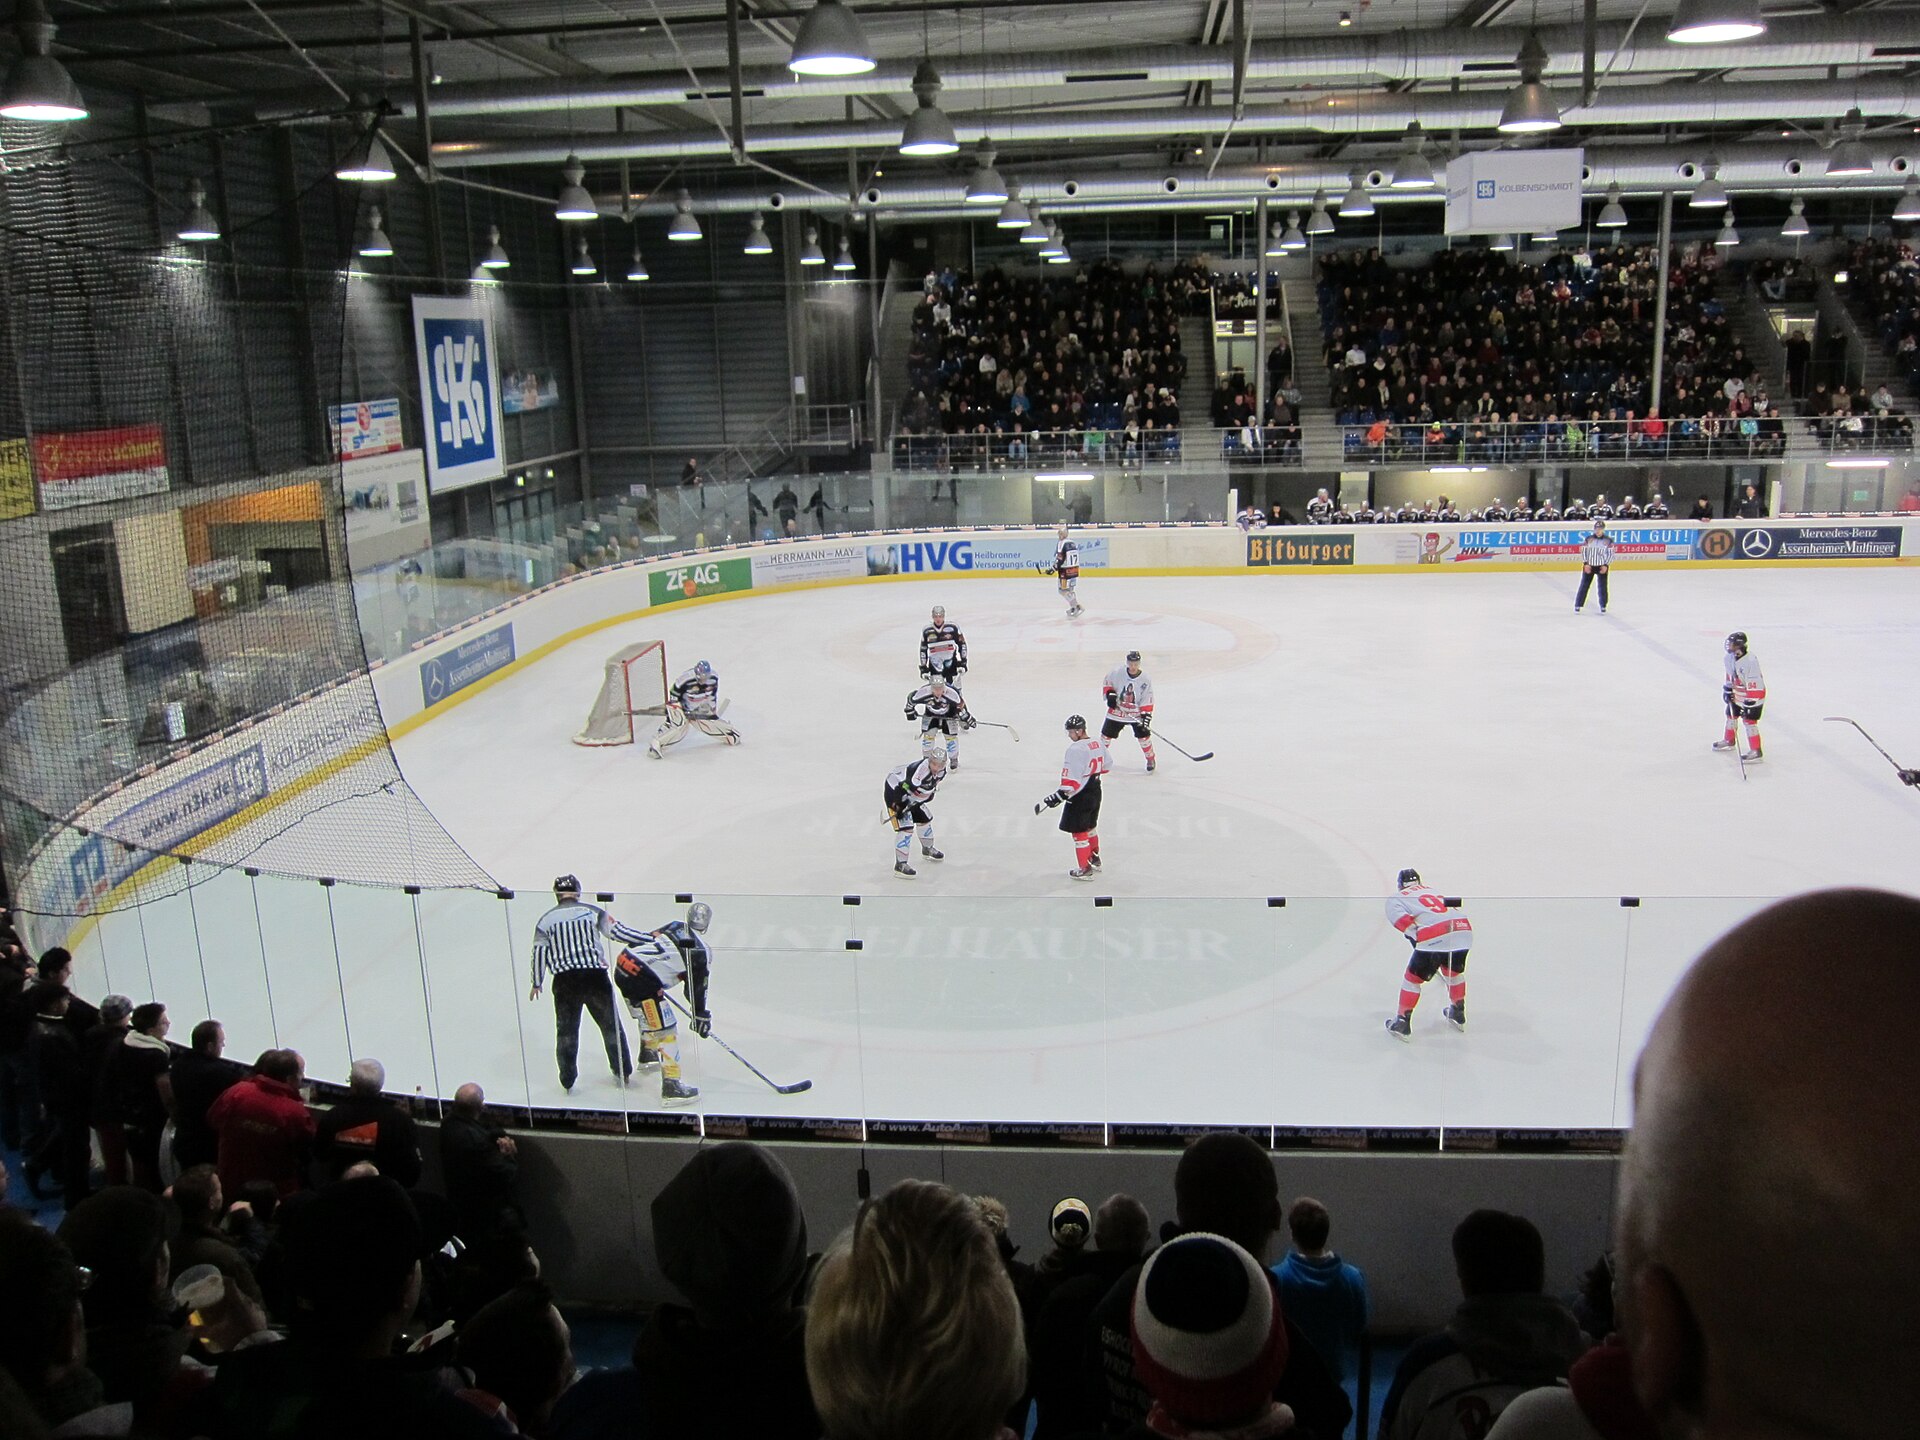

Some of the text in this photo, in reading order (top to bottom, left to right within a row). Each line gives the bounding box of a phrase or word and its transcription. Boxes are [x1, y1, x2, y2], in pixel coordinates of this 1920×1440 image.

[1498, 182, 1574, 193] KOLBENSCHMIDT
[1463, 531, 1491, 546] DIE
[1498, 531, 1569, 545] ZEICHEN
[1649, 529, 1689, 544] GUT!
[1800, 528, 1879, 538] Mercedes-Benz
[770, 550, 825, 564] HERRMANN
[834, 547, 855, 558] MAY
[974, 551, 1021, 560] Heilbronner
[1250, 538, 1353, 562] Bitburger
[1461, 546, 1489, 555] HNV
[1512, 546, 1537, 555] Mobil
[1540, 546, 1555, 555] mit
[1558, 546, 1575, 556] Bus,
[1621, 544, 1665, 554] Stadtbahn
[900, 540, 973, 573] HVG
[1069, 554, 1078, 566] 17
[974, 560, 1024, 571] Versorgungs
[1083, 756, 1109, 778] 27
[768, 1120, 800, 1129] www.
[869, 1121, 886, 1132] .de
[888, 1123, 921, 1132] www.
[922, 1123, 990, 1133] AutoArenA
[991, 1123, 1009, 1134] .de
[1011, 1125, 1044, 1134] www.
